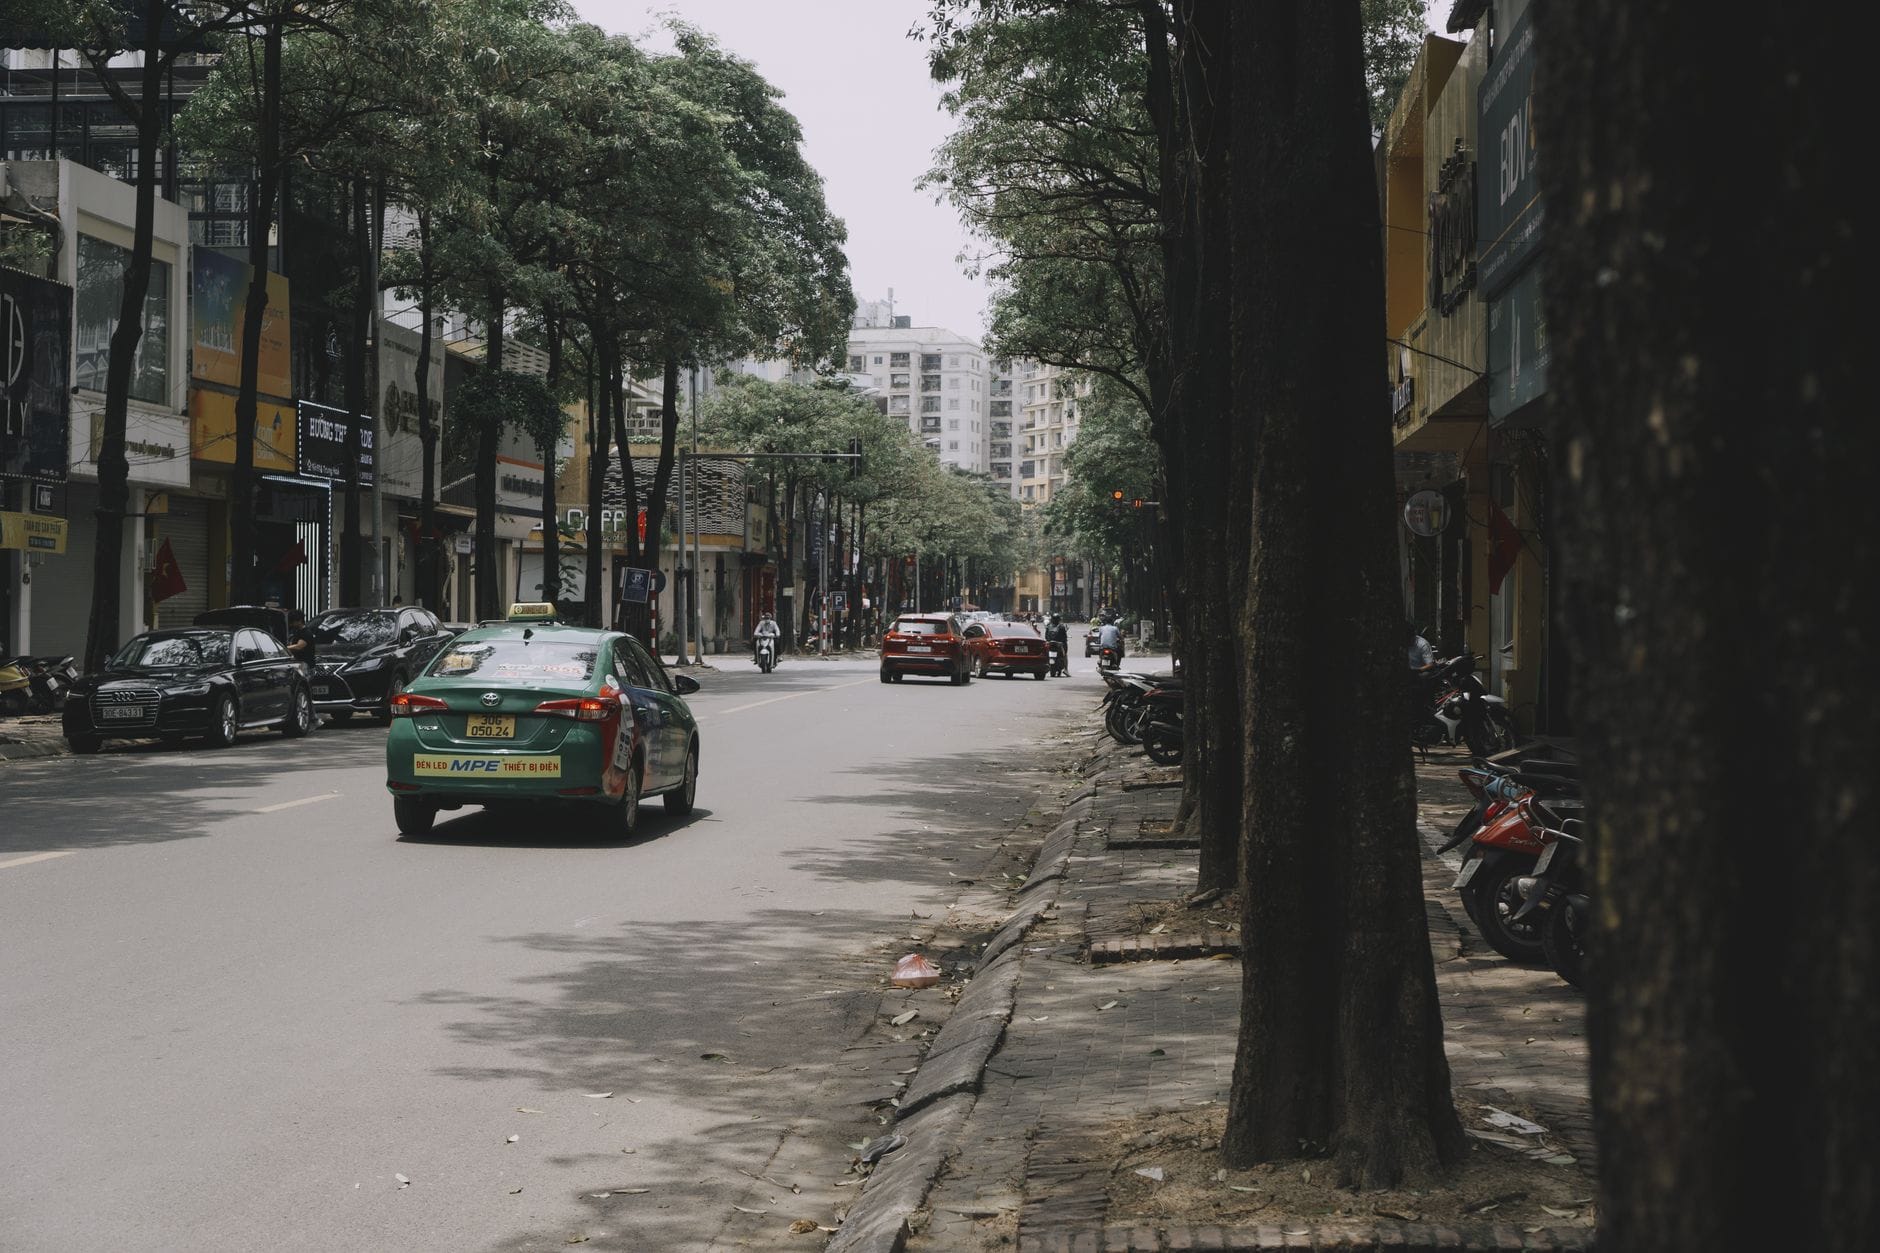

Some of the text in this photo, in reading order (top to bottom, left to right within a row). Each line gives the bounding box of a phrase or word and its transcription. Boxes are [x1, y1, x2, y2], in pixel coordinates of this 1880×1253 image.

[1500, 95, 1530, 207] BIDV
[835, 596, 842, 604] P
[481, 714, 502, 725] 30G
[471, 725, 509, 737] 050.24
[433, 761, 447, 770] LED
[450, 759, 500, 772] MPE
[504, 760, 526, 771] THIẾT
